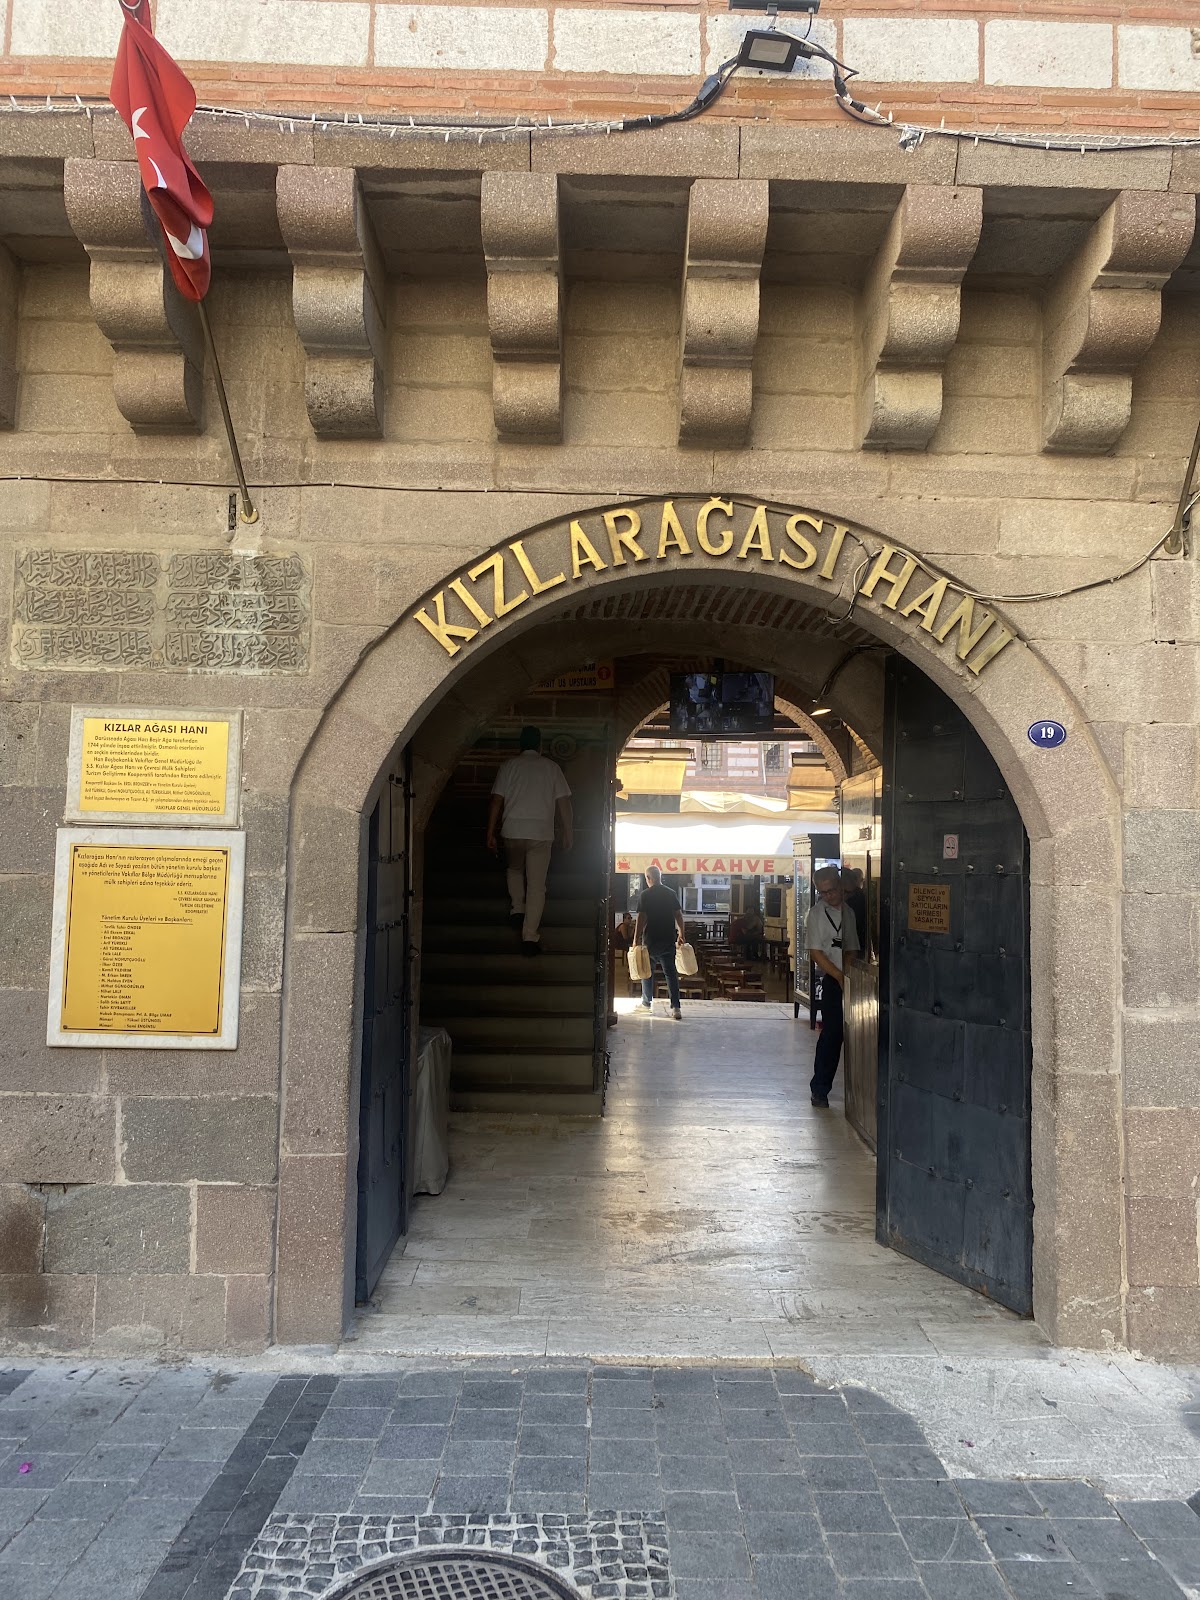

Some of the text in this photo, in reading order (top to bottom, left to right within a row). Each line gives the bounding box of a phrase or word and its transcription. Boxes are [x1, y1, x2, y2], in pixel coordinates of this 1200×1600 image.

[413, 497, 1015, 676] KIZLARAĞASI HANI
[558, 678, 566, 688] US
[569, 676, 597, 688] UPSTAIRS
[104, 722, 208, 734] KIZLAR AĞASI HANI
[1040, 726, 1055, 739] 19
[169, 758, 195, 766] Müdürlüğü
[174, 765, 196, 773] Sahipleri
[102, 770, 127, 778] Geliştirme
[128, 771, 154, 779] Kooperatifi
[77, 853, 104, 861] Kızlarağası
[156, 855, 192, 863] çalışmalarında
[650, 858, 775, 873] ACI KAHVE
[88, 870, 120, 878] yöneticilerine
[156, 872, 183, 880] Müdürlüğü
[183, 873, 217, 881] mensuplarına
[917, 895, 942, 903] SEYYAR
[911, 901, 948, 910] SATICILARIN
[139, 914, 157, 922] Üyeleri
[914, 916, 944, 925] YASAKTIR
